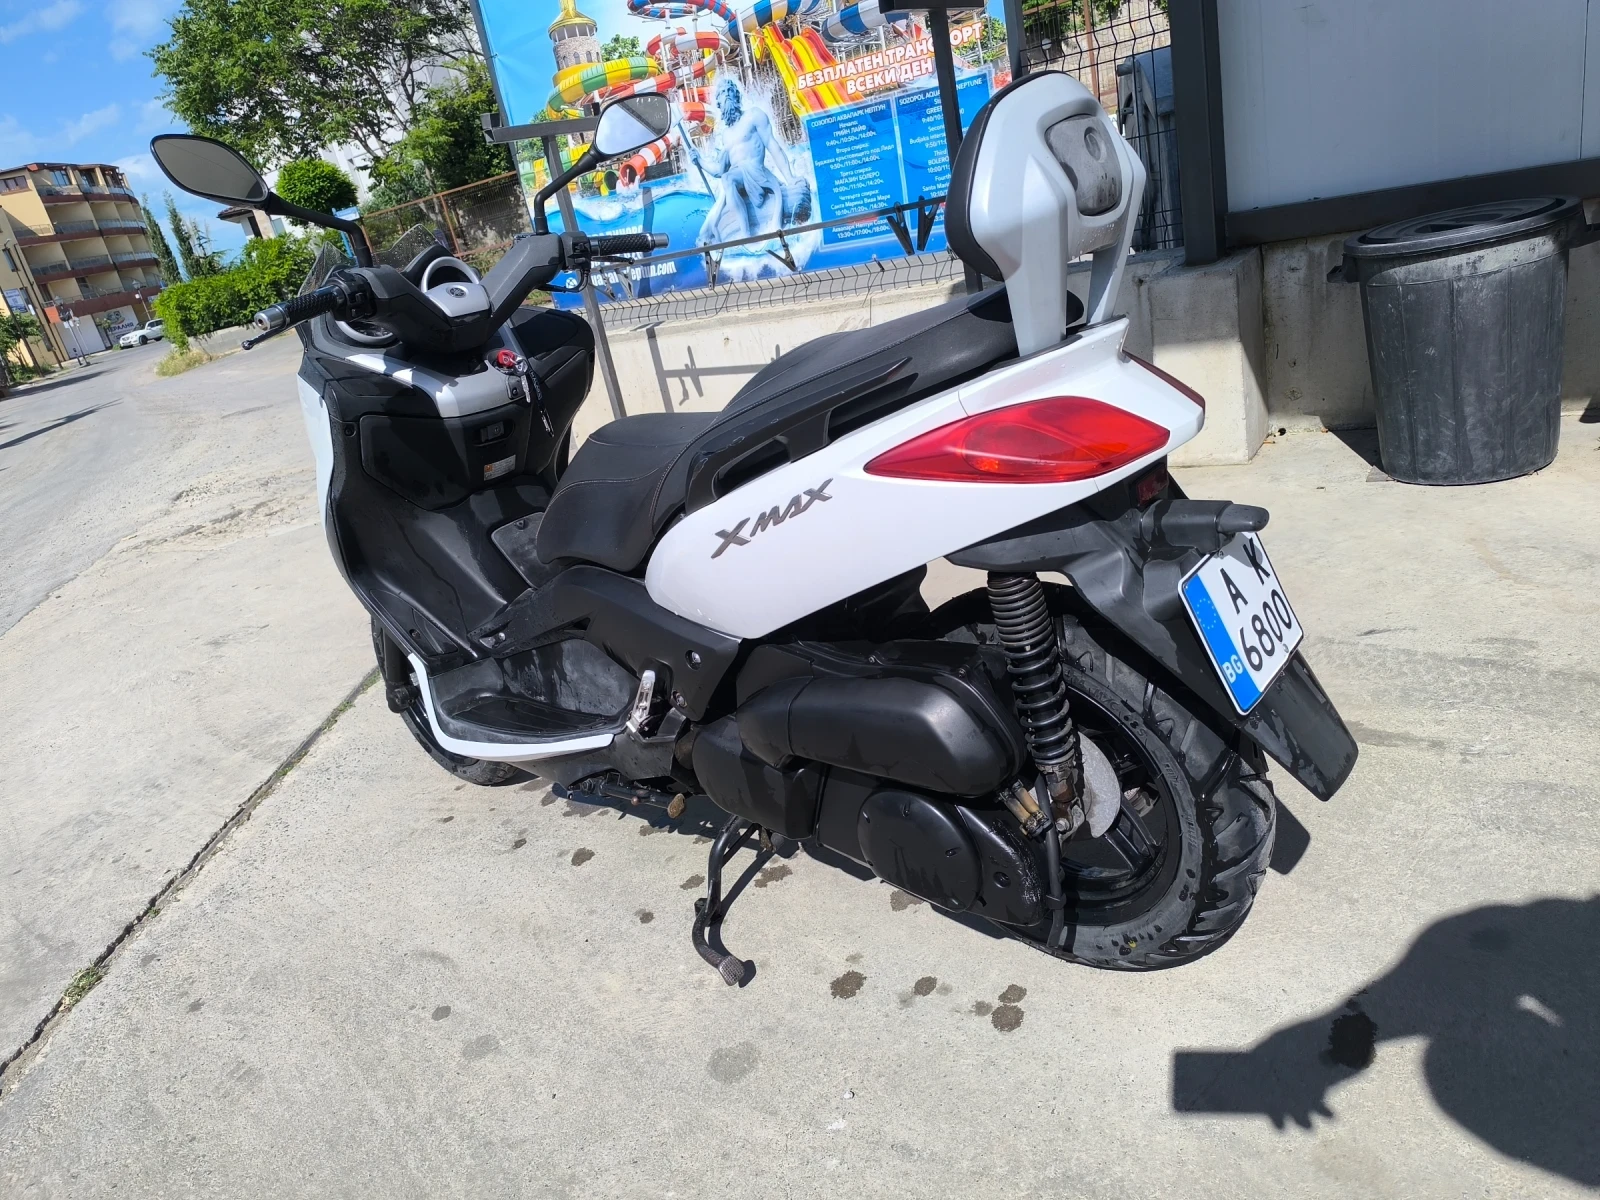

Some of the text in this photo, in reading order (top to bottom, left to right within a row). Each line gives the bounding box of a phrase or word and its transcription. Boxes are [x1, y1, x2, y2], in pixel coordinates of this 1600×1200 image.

[797, 21, 984, 90] БЕЗПЛАТЕН ТРАНСОРТ
[846, 58, 934, 95] ВСЕКИ ДЕН
[837, 110, 864, 121] АКВАПАРК
[865, 104, 886, 114] НЕПТУН
[899, 94, 925, 105] SOZOPOL
[926, 106, 942, 115] GREE
[859, 171, 880, 181] БОЛЕРО
[710, 477, 834, 560] XMAX
[1220, 537, 1270, 616] A K
[1240, 588, 1292, 672] 6800
[1222, 654, 1244, 684] BG
